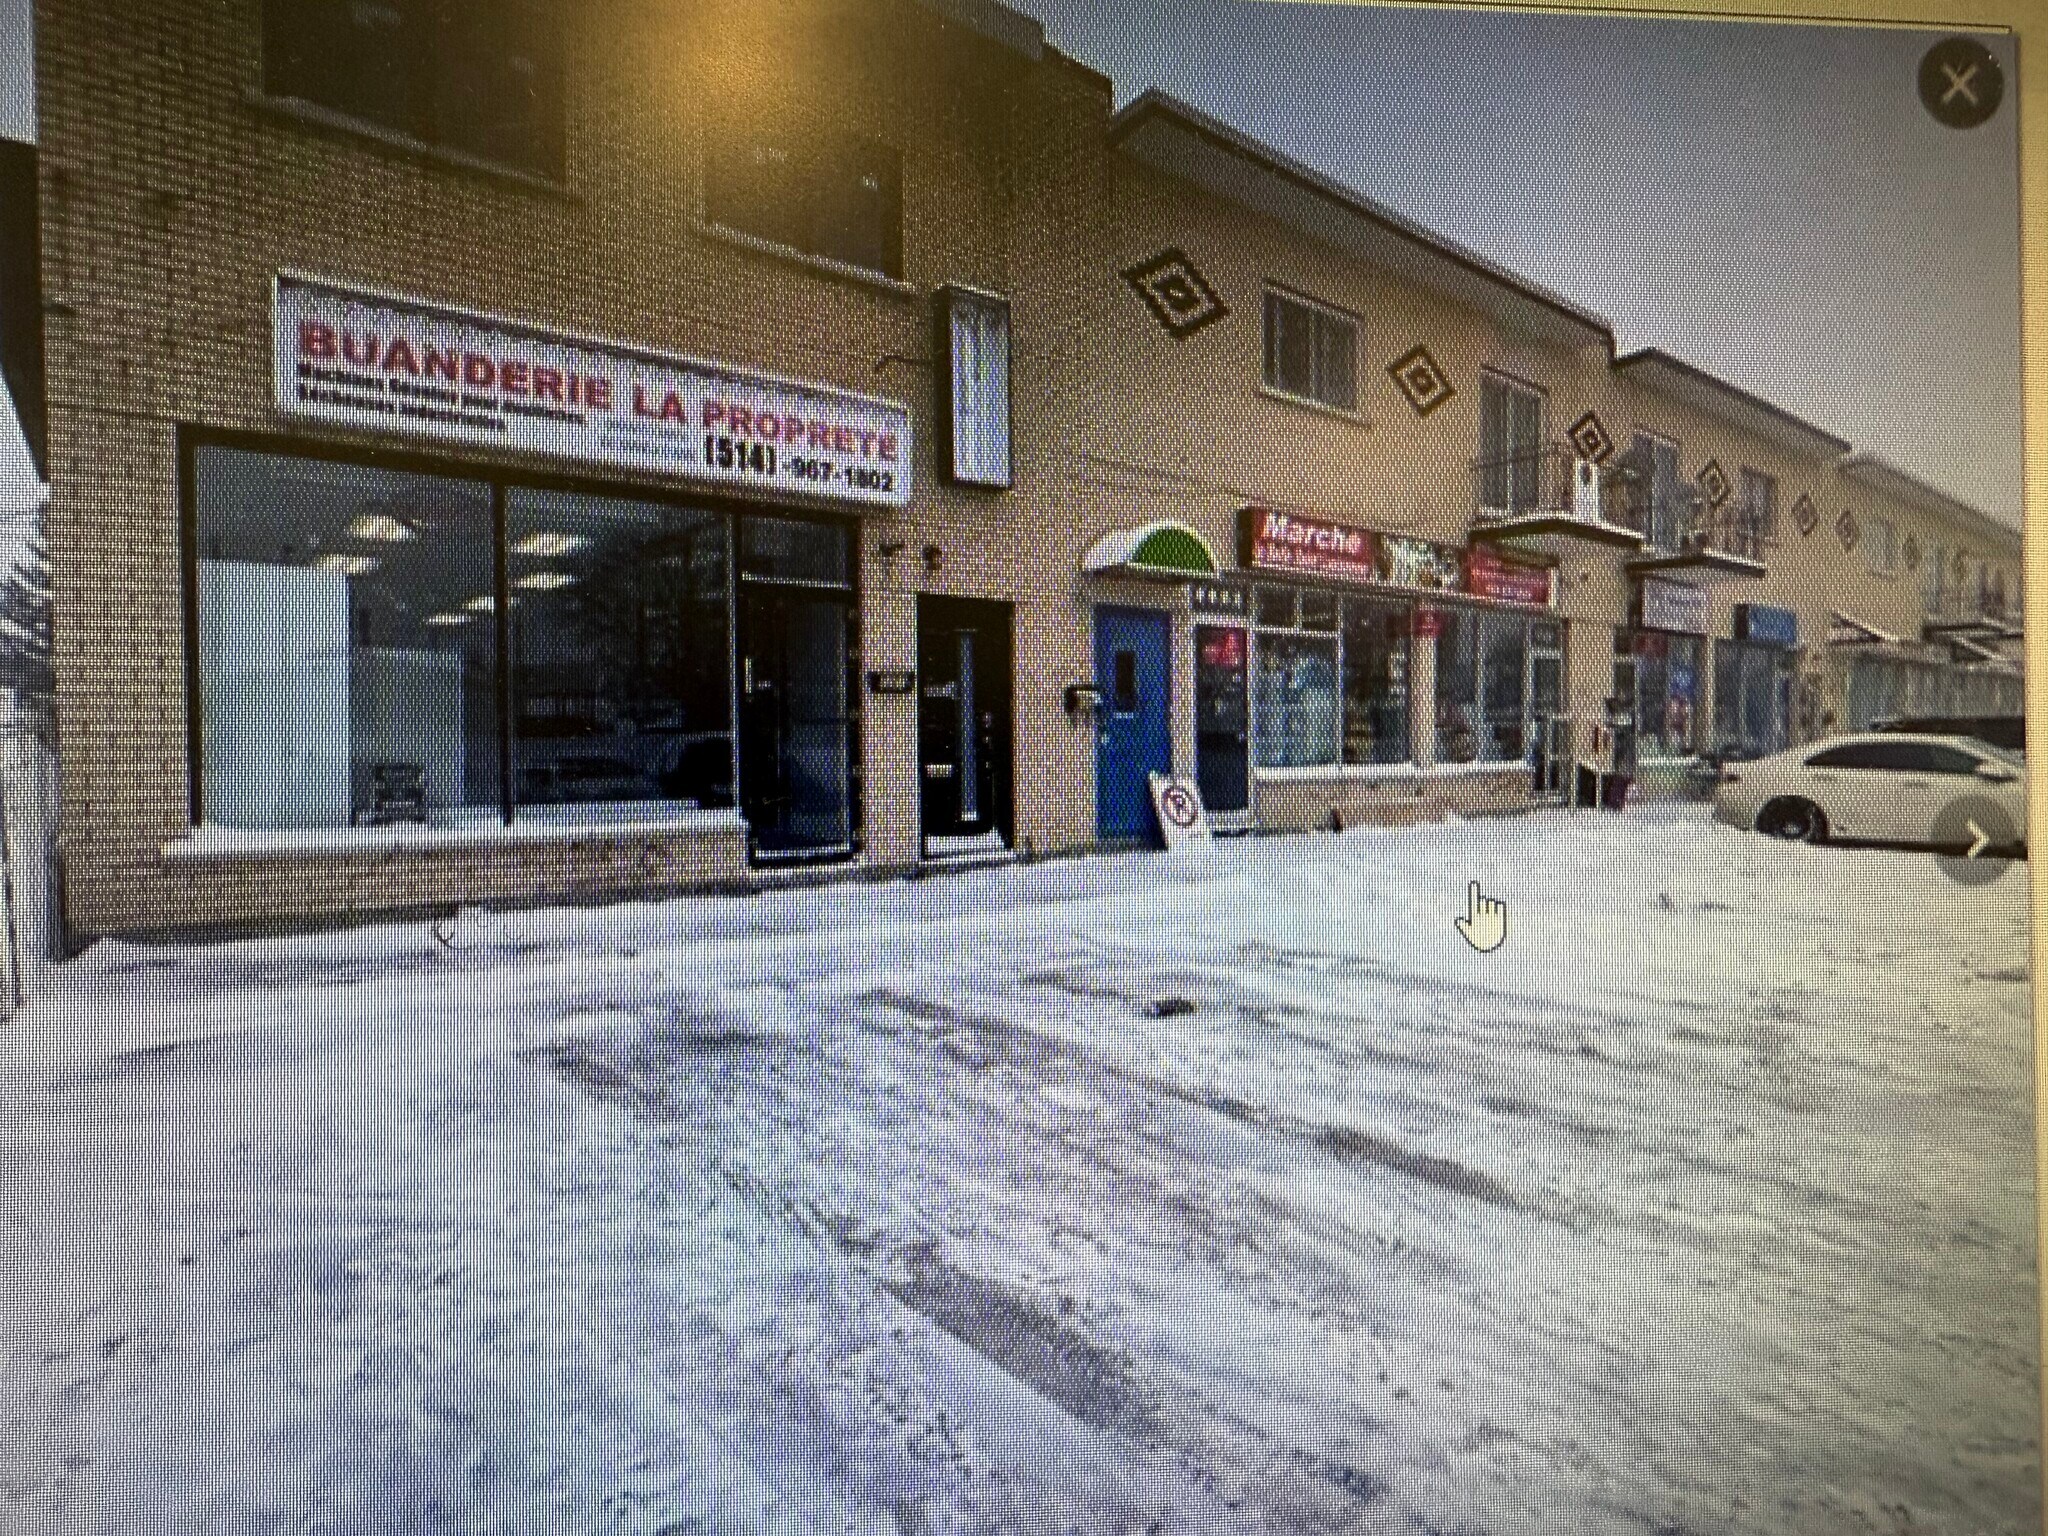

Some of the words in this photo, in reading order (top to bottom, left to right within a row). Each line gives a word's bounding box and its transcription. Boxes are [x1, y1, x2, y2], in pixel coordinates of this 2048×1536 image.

[298, 318, 613, 410] BUANDERIE
[633, 380, 685, 423] LA
[705, 434, 777, 475] (514)
